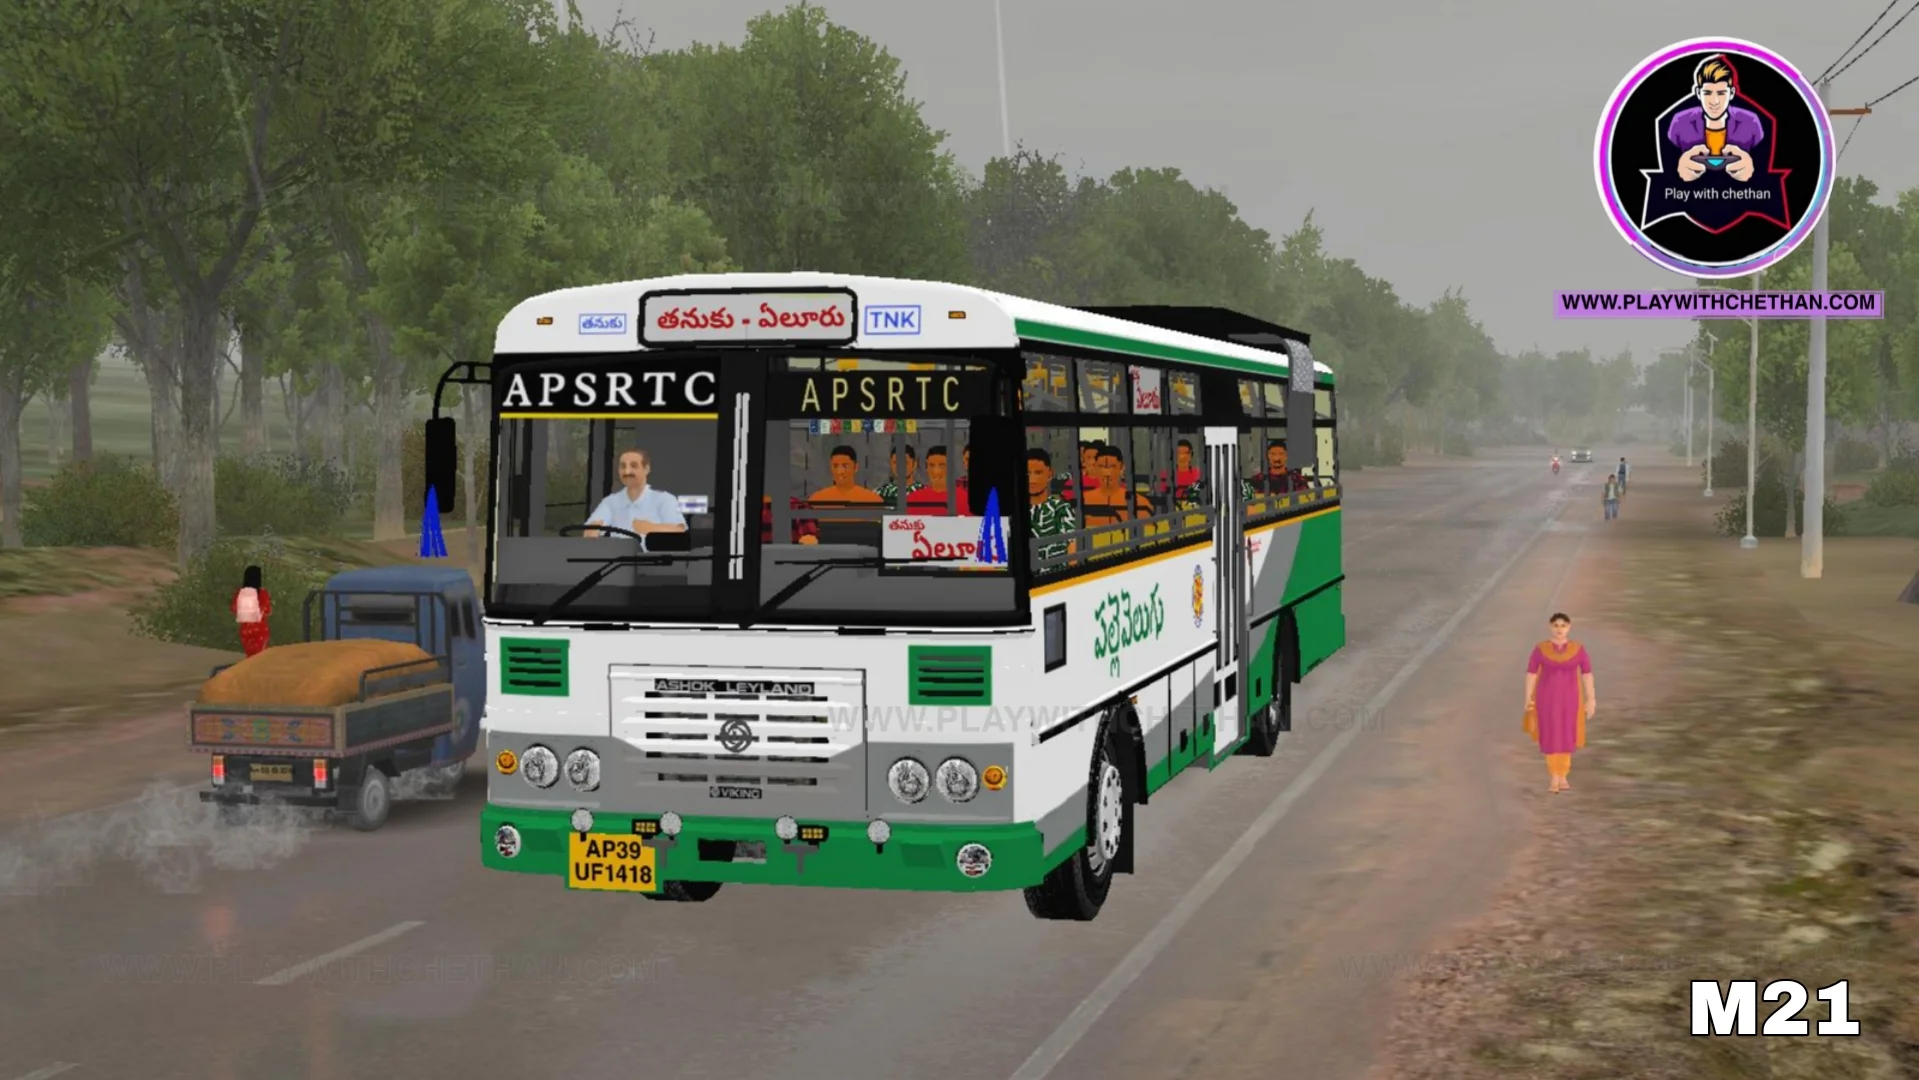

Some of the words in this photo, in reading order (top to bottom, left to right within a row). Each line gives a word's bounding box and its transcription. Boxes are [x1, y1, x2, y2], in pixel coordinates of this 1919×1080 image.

[582, 317, 623, 330] తనుకు
[657, 307, 735, 329] తనుకు
[758, 302, 845, 328] ఏలూరు
[870, 311, 915, 329] TNK
[502, 371, 716, 407] APSRTC
[801, 376, 959, 412] APSRTC
[655, 680, 716, 692] ASHOK
[726, 681, 812, 695] LEYLAND
[721, 787, 761, 799] VIKING
[586, 839, 641, 860] AP39
[575, 862, 652, 884] UF1418
